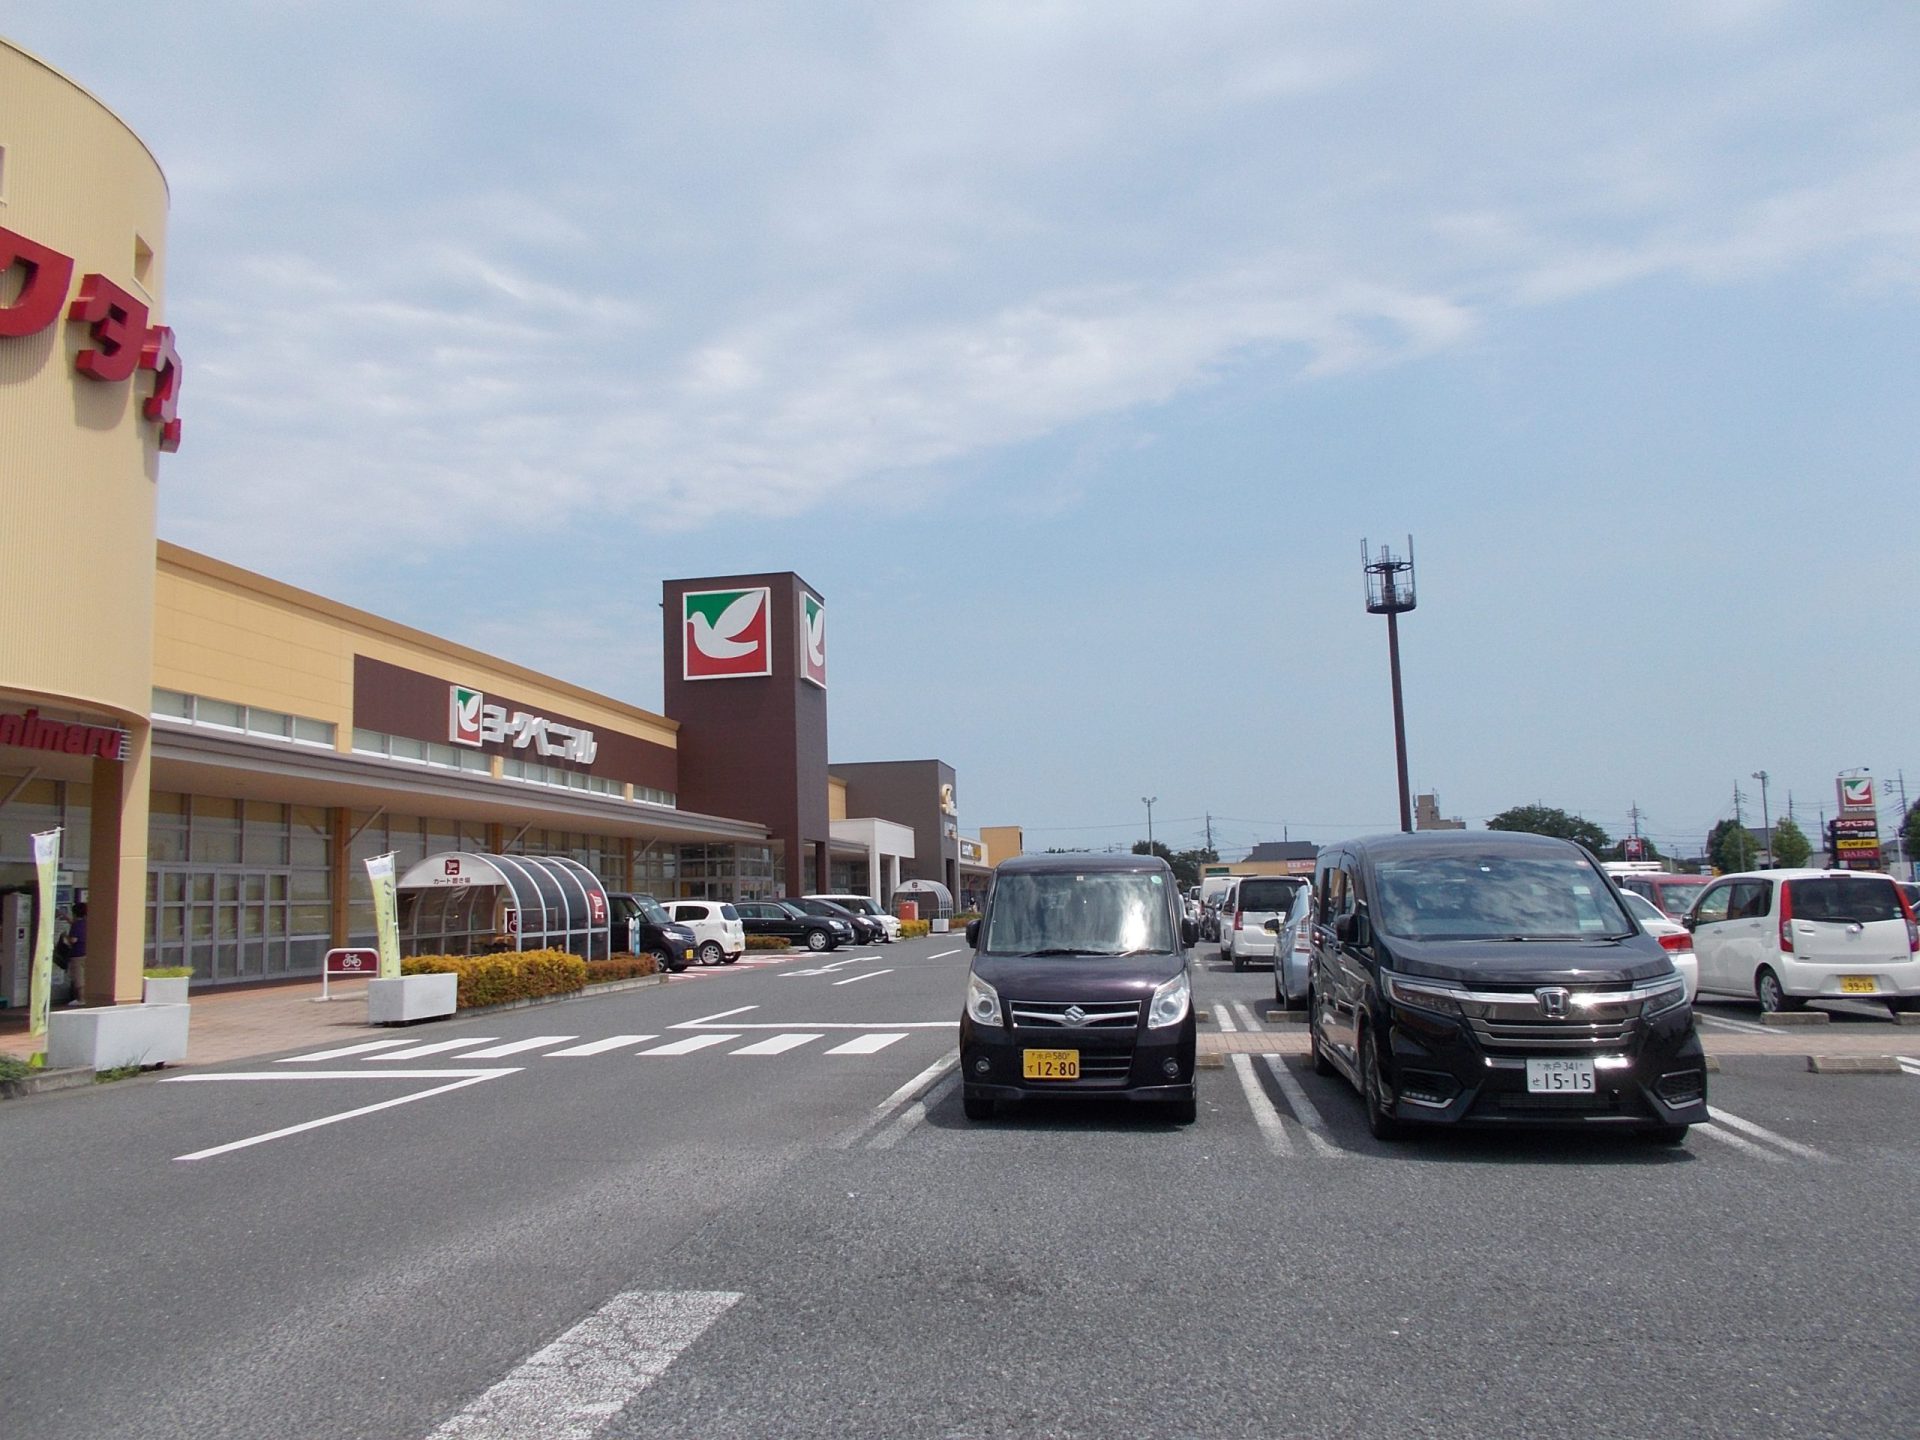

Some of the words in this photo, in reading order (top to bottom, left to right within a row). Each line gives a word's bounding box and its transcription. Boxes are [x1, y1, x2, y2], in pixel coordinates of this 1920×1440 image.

[482, 704, 598, 765] ヨークベニマル
[1037, 1062, 1076, 1076] 12-80
[1545, 1073, 1591, 1089] 15-15
